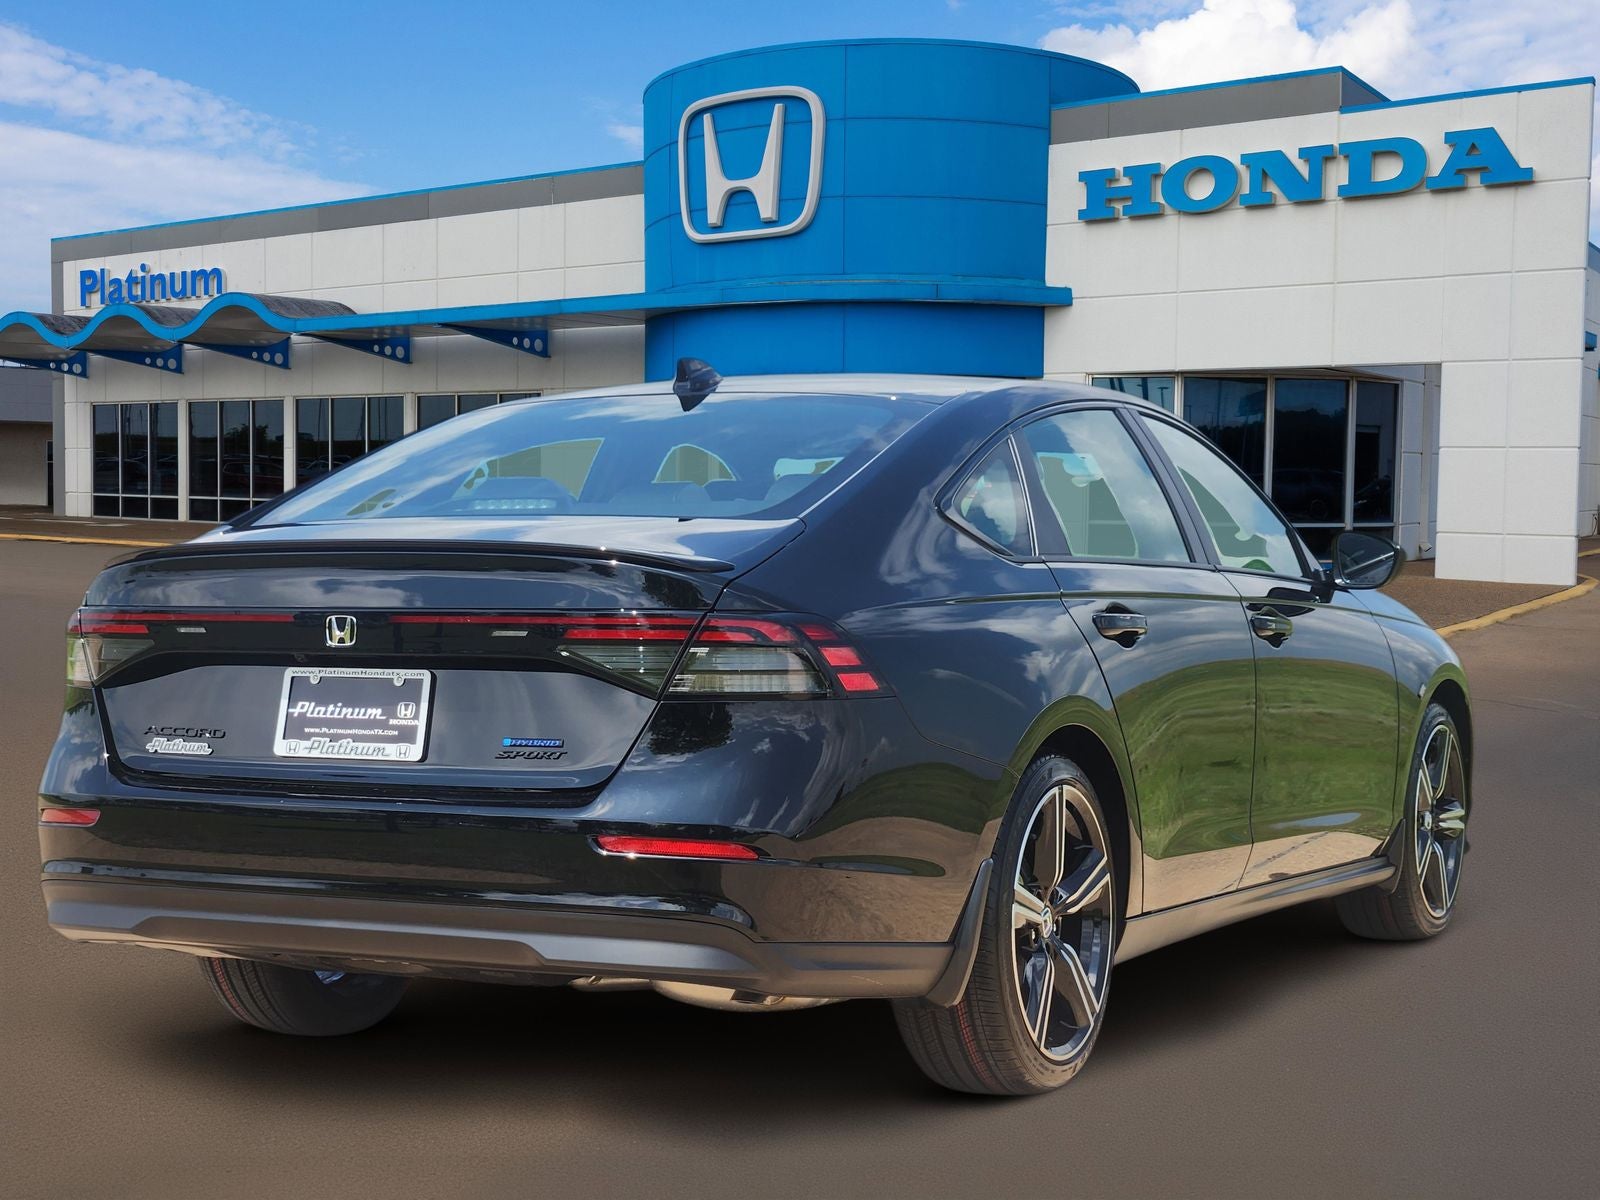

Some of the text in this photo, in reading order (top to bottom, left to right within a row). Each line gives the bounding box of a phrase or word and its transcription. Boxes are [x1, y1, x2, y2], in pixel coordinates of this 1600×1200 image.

[1078, 126, 1534, 221] HONDA
[80, 262, 226, 307] Platinum
[288, 701, 387, 720] Platinum
[143, 726, 226, 739] ACCORD
[145, 737, 214, 755] Platinum
[304, 740, 391, 757] Platinum
[510, 738, 561, 748] HYBRID
[495, 751, 568, 761] SPORT
